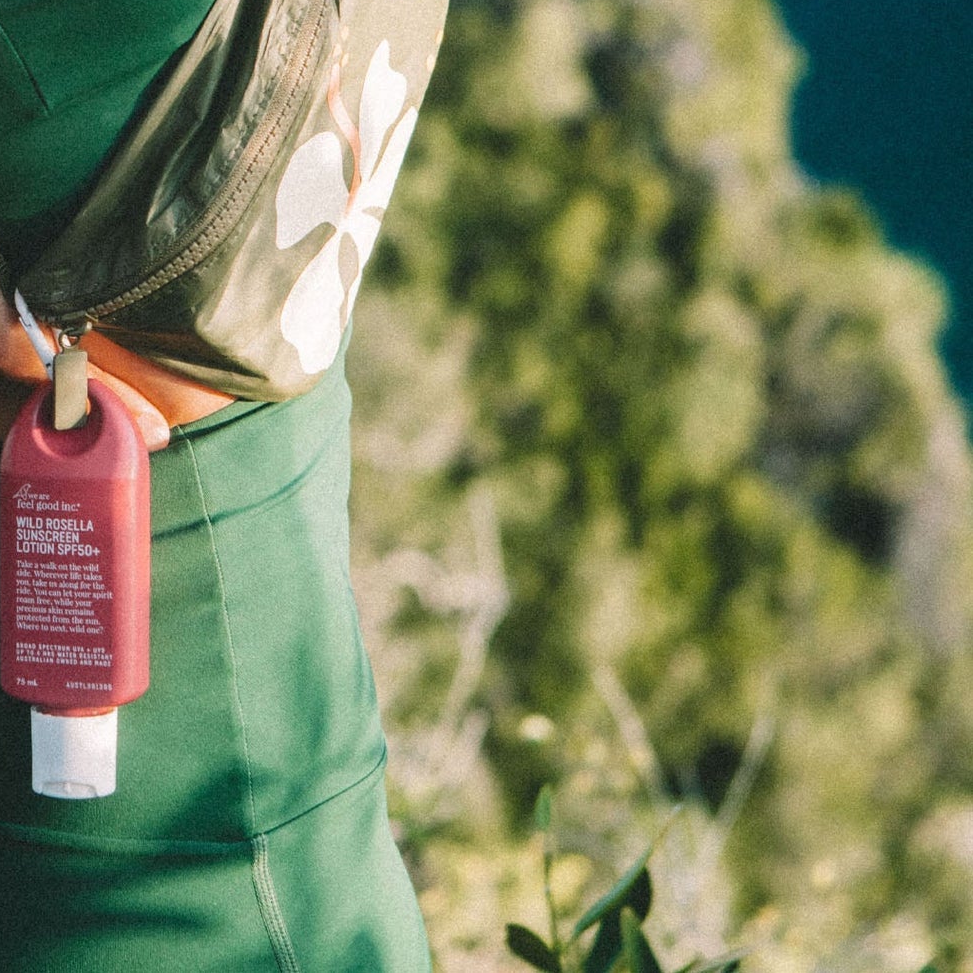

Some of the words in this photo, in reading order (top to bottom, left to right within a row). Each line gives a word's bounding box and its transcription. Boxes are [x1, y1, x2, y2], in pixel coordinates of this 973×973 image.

[17, 499, 34, 508] feel
[36, 501, 59, 511] good
[16, 516, 42, 528] WILD
[46, 518, 94, 532] ROSELLA
[16, 528, 80, 543] SUNSCREEN
[16, 542, 54, 554] LOTION
[58, 544, 100, 556] SPF50+
[16, 560, 33, 568] Take
[40, 562, 57, 570] walk
[69, 563, 82, 571] the
[83, 564, 99, 572] wild
[34, 570, 68, 578] Wherever
[70, 572, 82, 580] life
[32, 579, 47, 587] take
[59, 581, 78, 589] along
[80, 581, 91, 589] for
[93, 582, 105, 590] the
[92, 591, 113, 600] spirit
[54, 598, 74, 606] while
[16, 605, 47, 613] precious
[16, 614, 50, 622] protected
[52, 615, 70, 624] from
[72, 616, 84, 624] the
[16, 622, 40, 630] Where
[70, 625, 85, 633] wild
[16, 677, 26, 685] 75
[27, 678, 38, 686] mL
